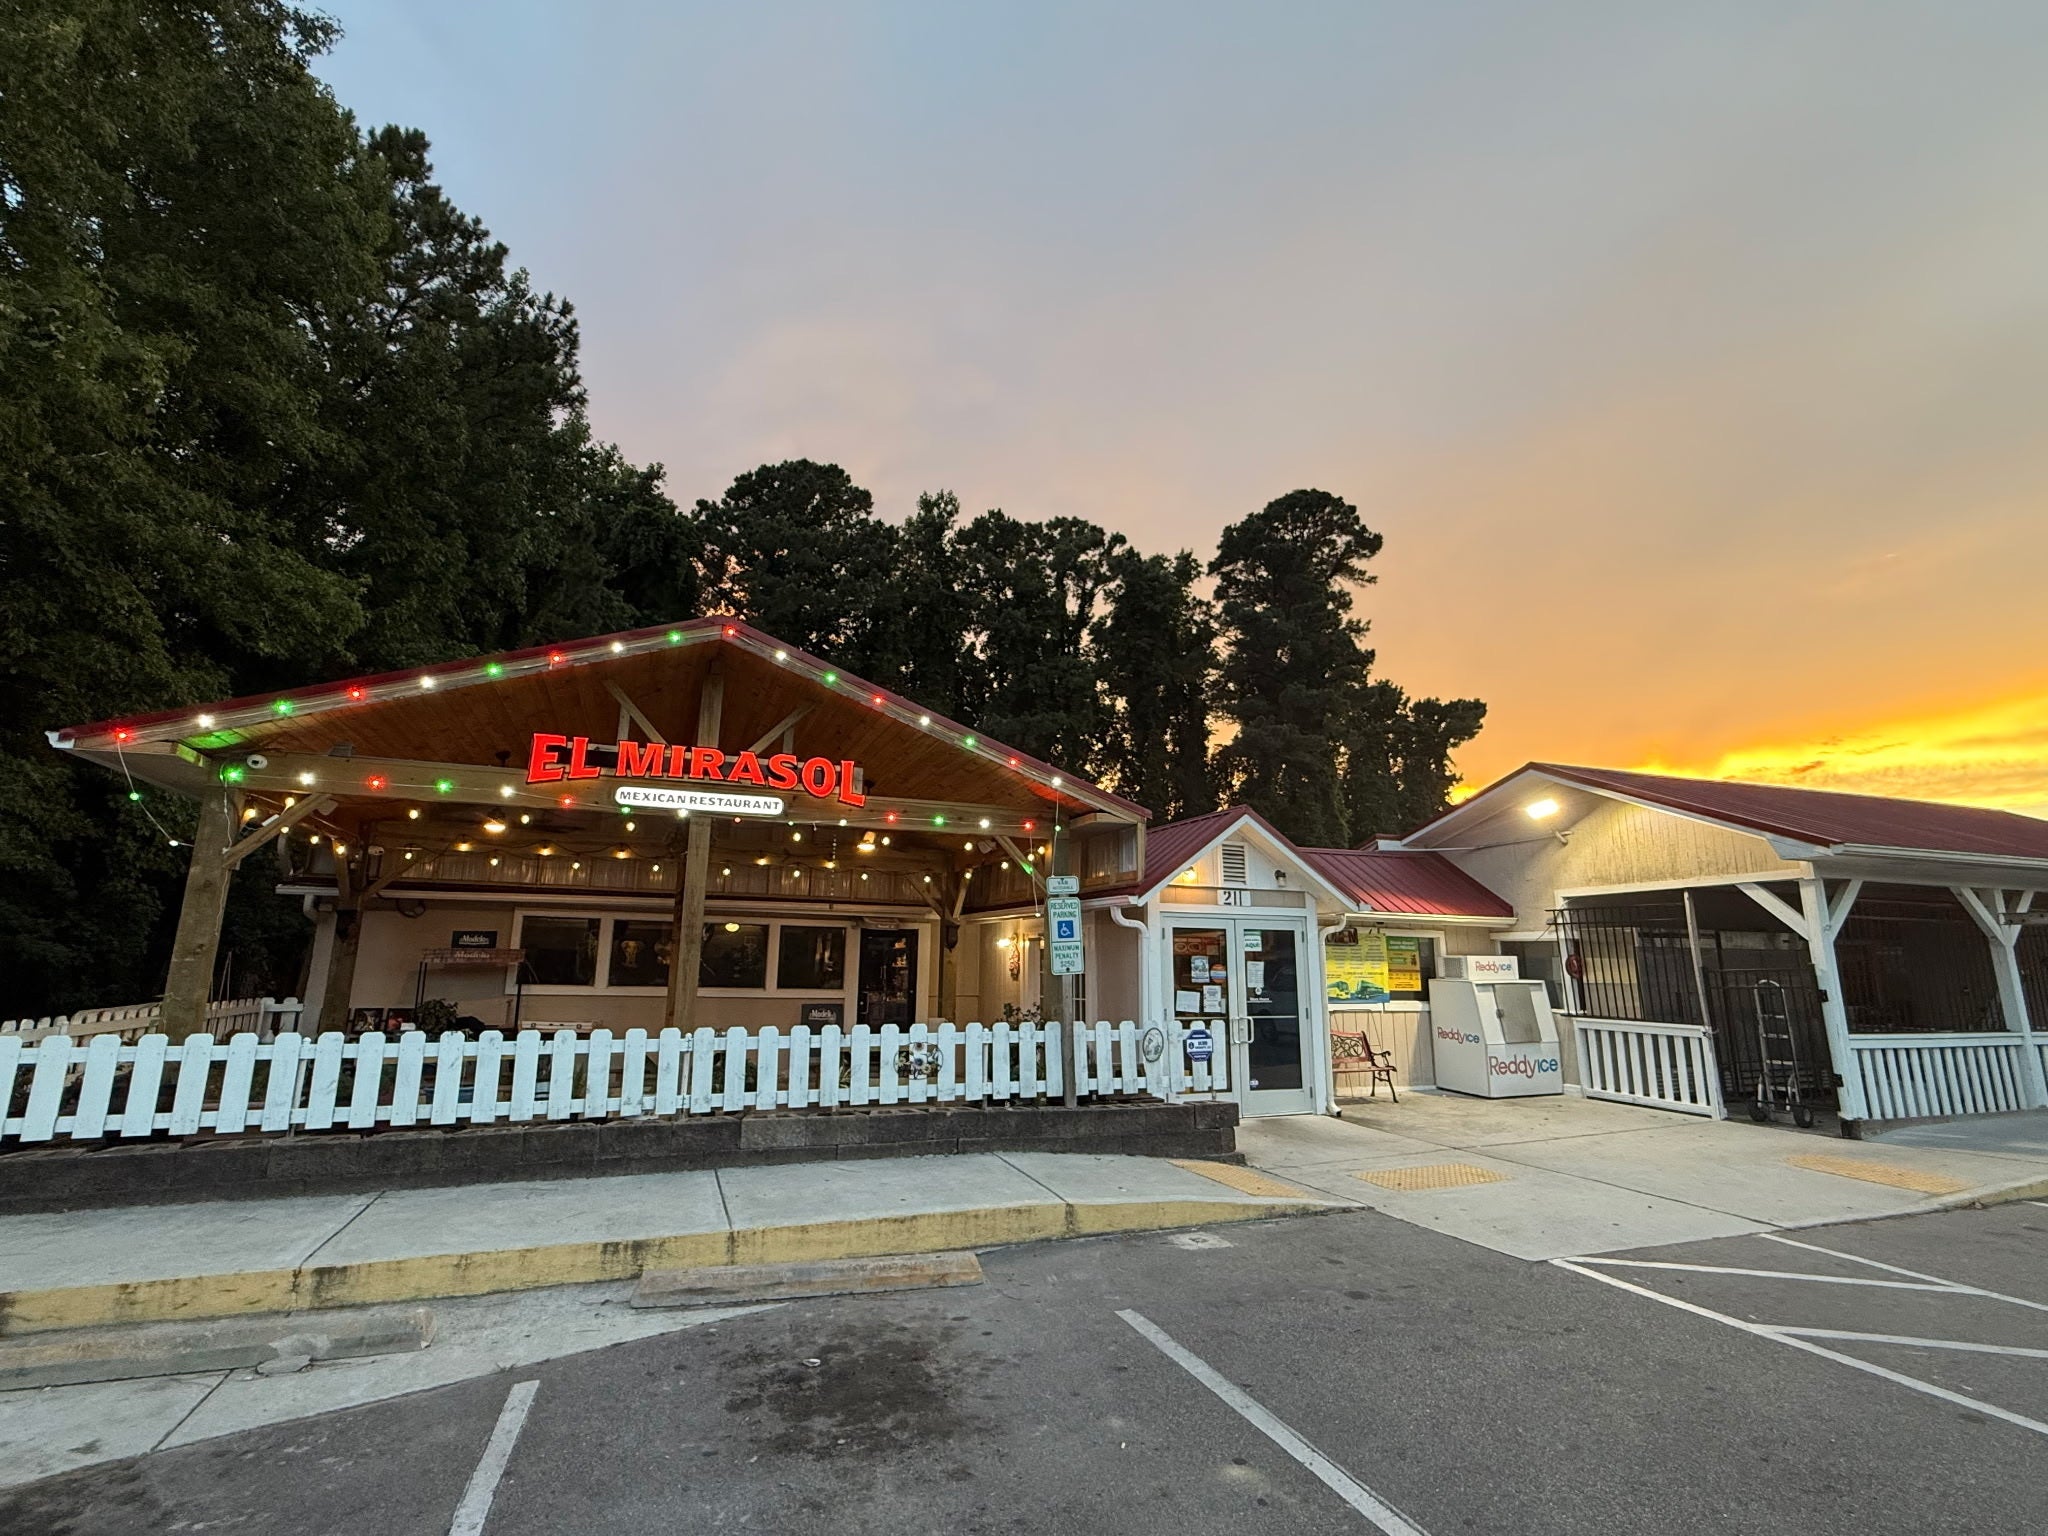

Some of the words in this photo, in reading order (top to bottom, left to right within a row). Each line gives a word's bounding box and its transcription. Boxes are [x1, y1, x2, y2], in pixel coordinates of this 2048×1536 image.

[527, 732, 601, 784] EL
[614, 740, 866, 808] MIRASOL
[619, 790, 687, 804] MEXICAN
[689, 795, 780, 811] RESTAURANT
[1223, 890, 1242, 906] 211
[1050, 902, 1078, 910] RESERVED
[1053, 911, 1077, 919] PARKING
[1055, 952, 1079, 960] PENALTY
